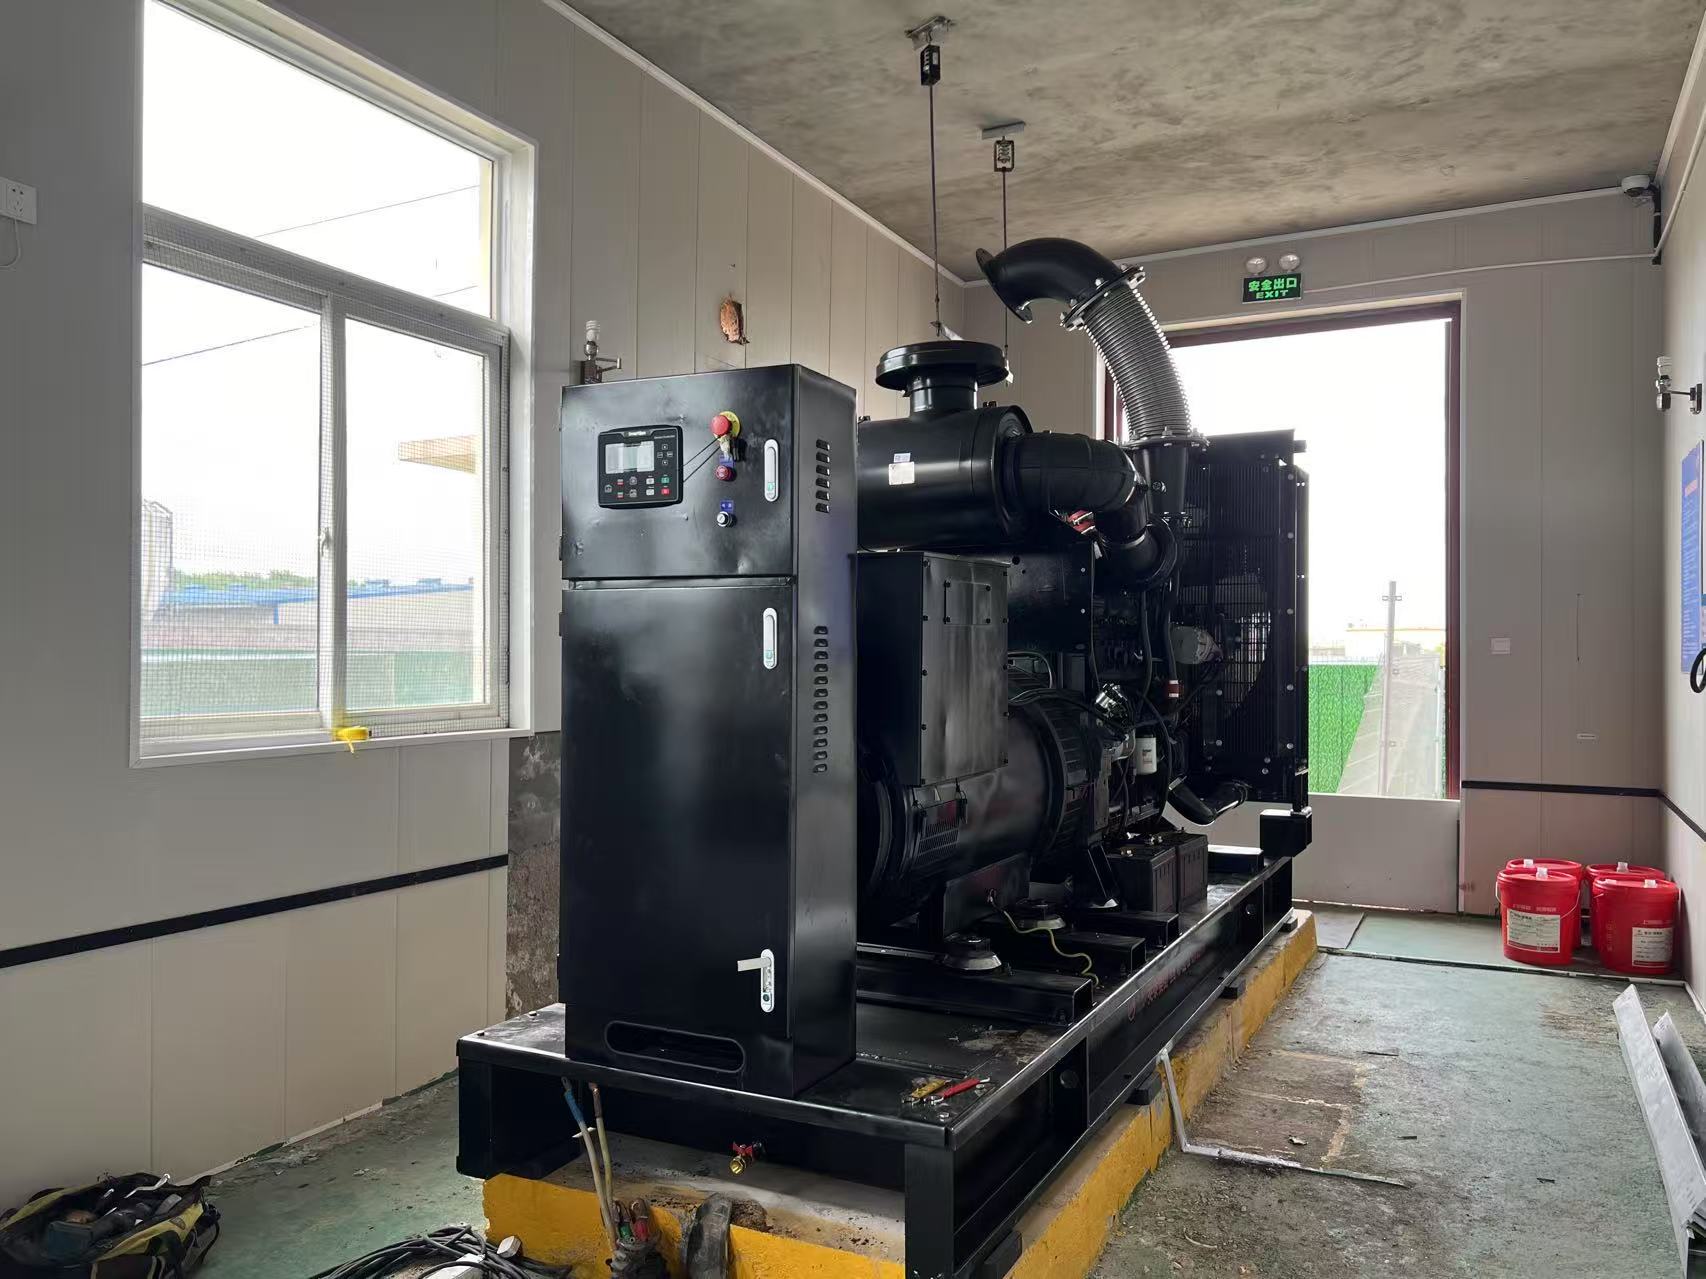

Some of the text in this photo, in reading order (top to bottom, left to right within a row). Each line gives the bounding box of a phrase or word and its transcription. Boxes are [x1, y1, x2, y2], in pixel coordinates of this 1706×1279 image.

[1248, 277, 1298, 292] 安全出口
[1255, 289, 1289, 299] EXIT
